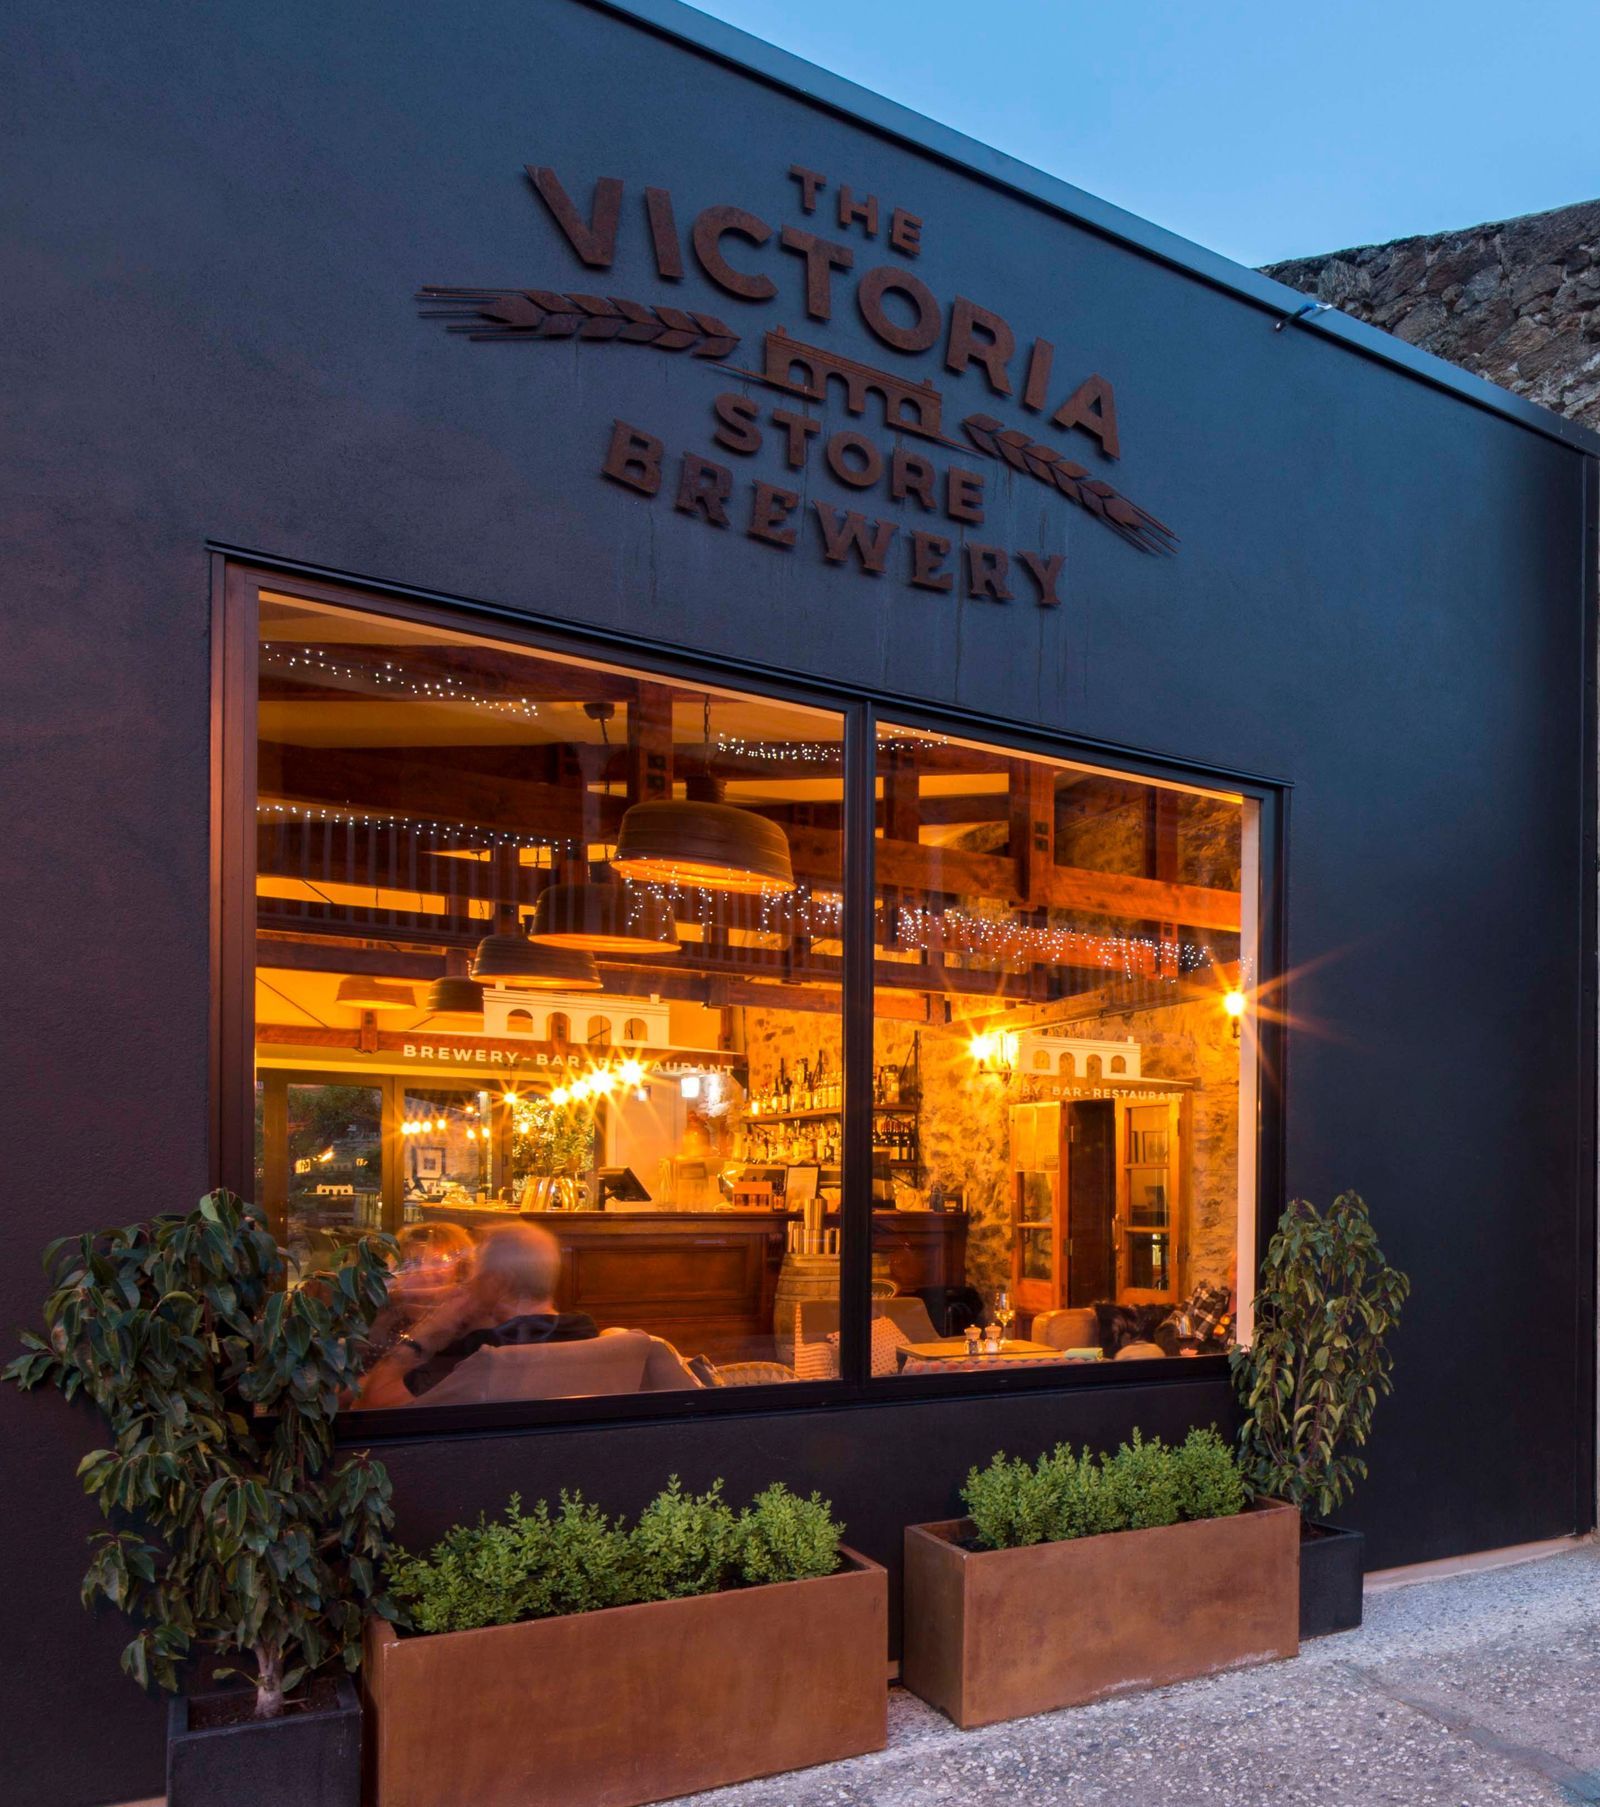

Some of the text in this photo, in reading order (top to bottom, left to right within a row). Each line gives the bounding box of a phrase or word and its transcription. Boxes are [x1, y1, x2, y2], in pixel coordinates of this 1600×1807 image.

[789, 164, 922, 256] THE
[523, 164, 1121, 461] VICTORIA
[601, 418, 1069, 607] BREWERY
[713, 392, 986, 524] STORE
[403, 1044, 519, 1064] BREWERY
[536, 1053, 580, 1067] BAR
